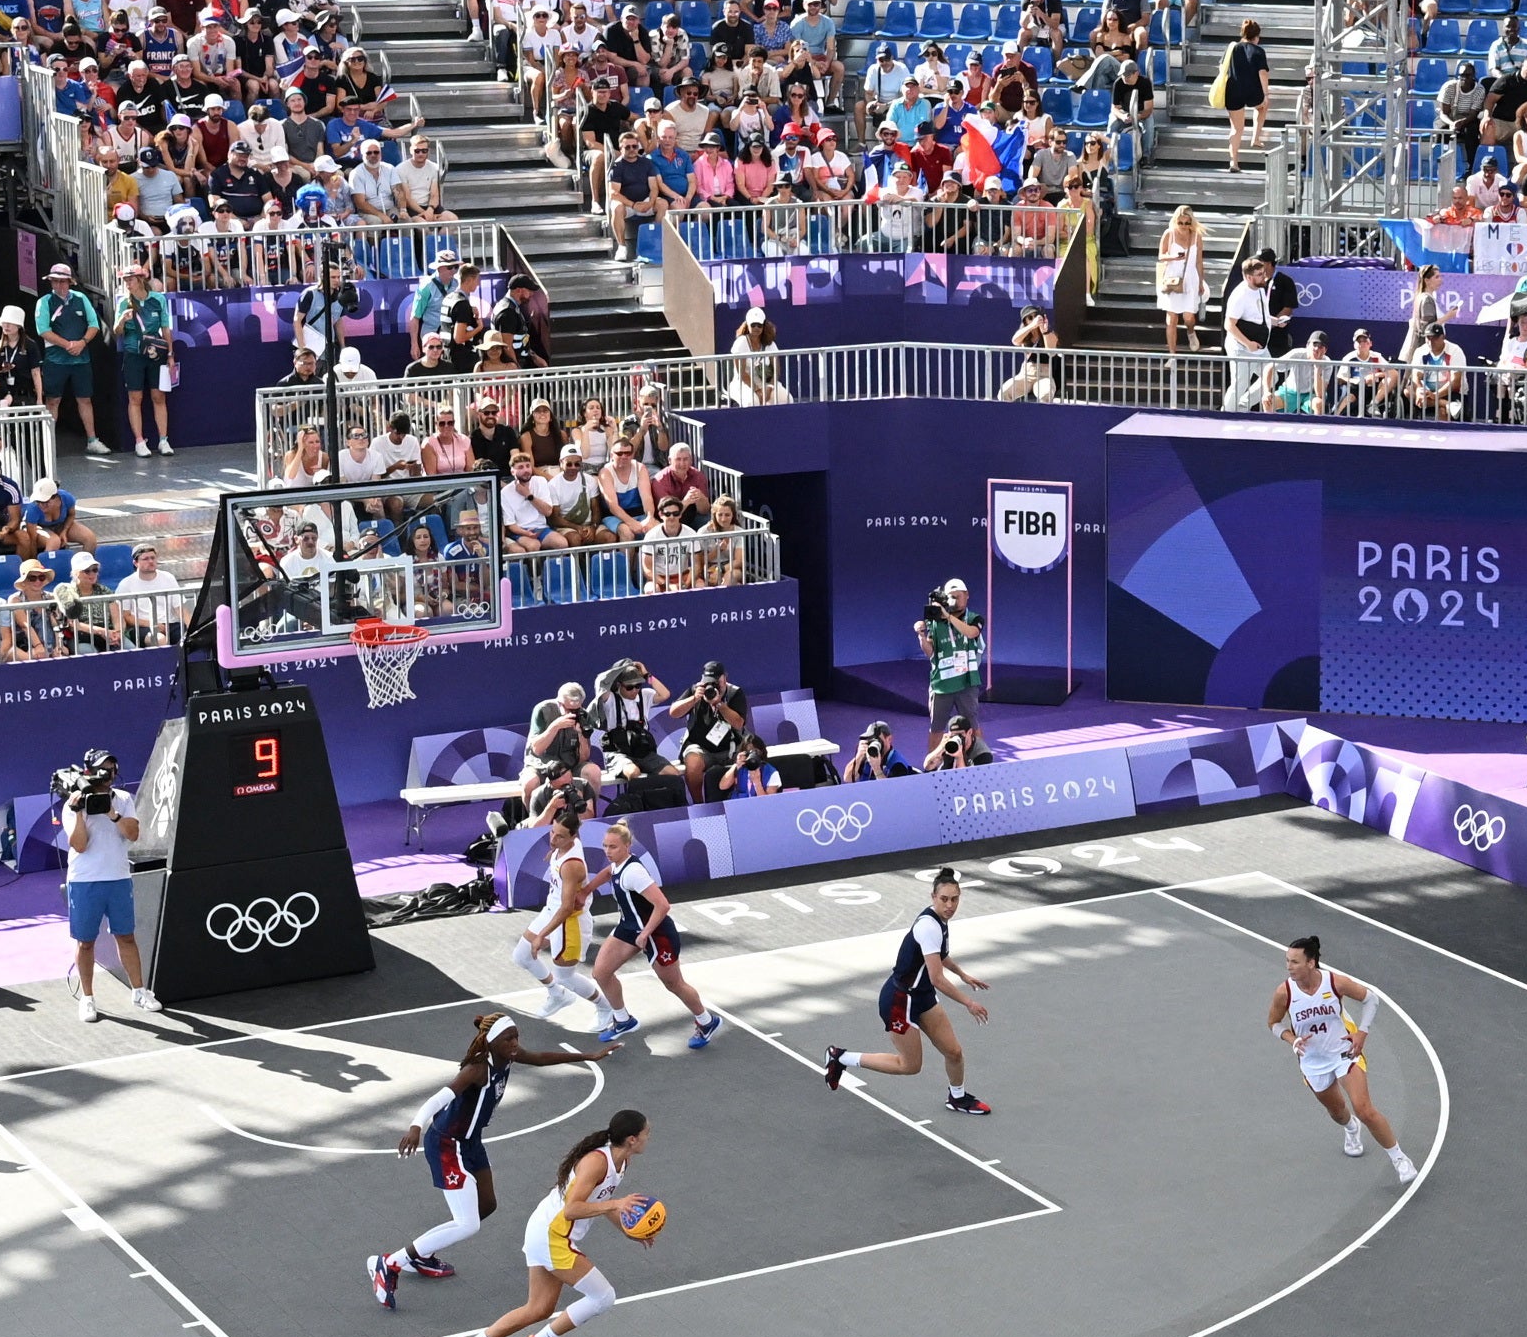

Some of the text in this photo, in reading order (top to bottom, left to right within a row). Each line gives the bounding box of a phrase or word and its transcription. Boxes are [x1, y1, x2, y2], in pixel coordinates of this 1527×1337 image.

[1487, 223, 1499, 240] M
[865, 515, 947, 528] PARIS 2024
[1004, 509, 1057, 536] FIBA
[1074, 523, 1105, 534] PARI
[1358, 541, 1500, 584] PARIS
[711, 605, 795, 625] PARIS 2024
[1358, 585, 1500, 629] 2024
[599, 617, 687, 637] PARIS 2024
[484, 630, 575, 650] PARIS 2024
[417, 644, 458, 658] 2024
[295, 656, 338, 671] 2024
[38, 685, 84, 701] 2024
[113, 675, 163, 692] PARIS
[199, 699, 306, 725] PARIS 2024
[255, 738, 277, 778] 9
[246, 783, 276, 794] OMEGA
[953, 775, 1116, 816] PARIS 2024
[1295, 1003, 1337, 1023] ESPAÑA
[1309, 1022, 1329, 1035] 44
